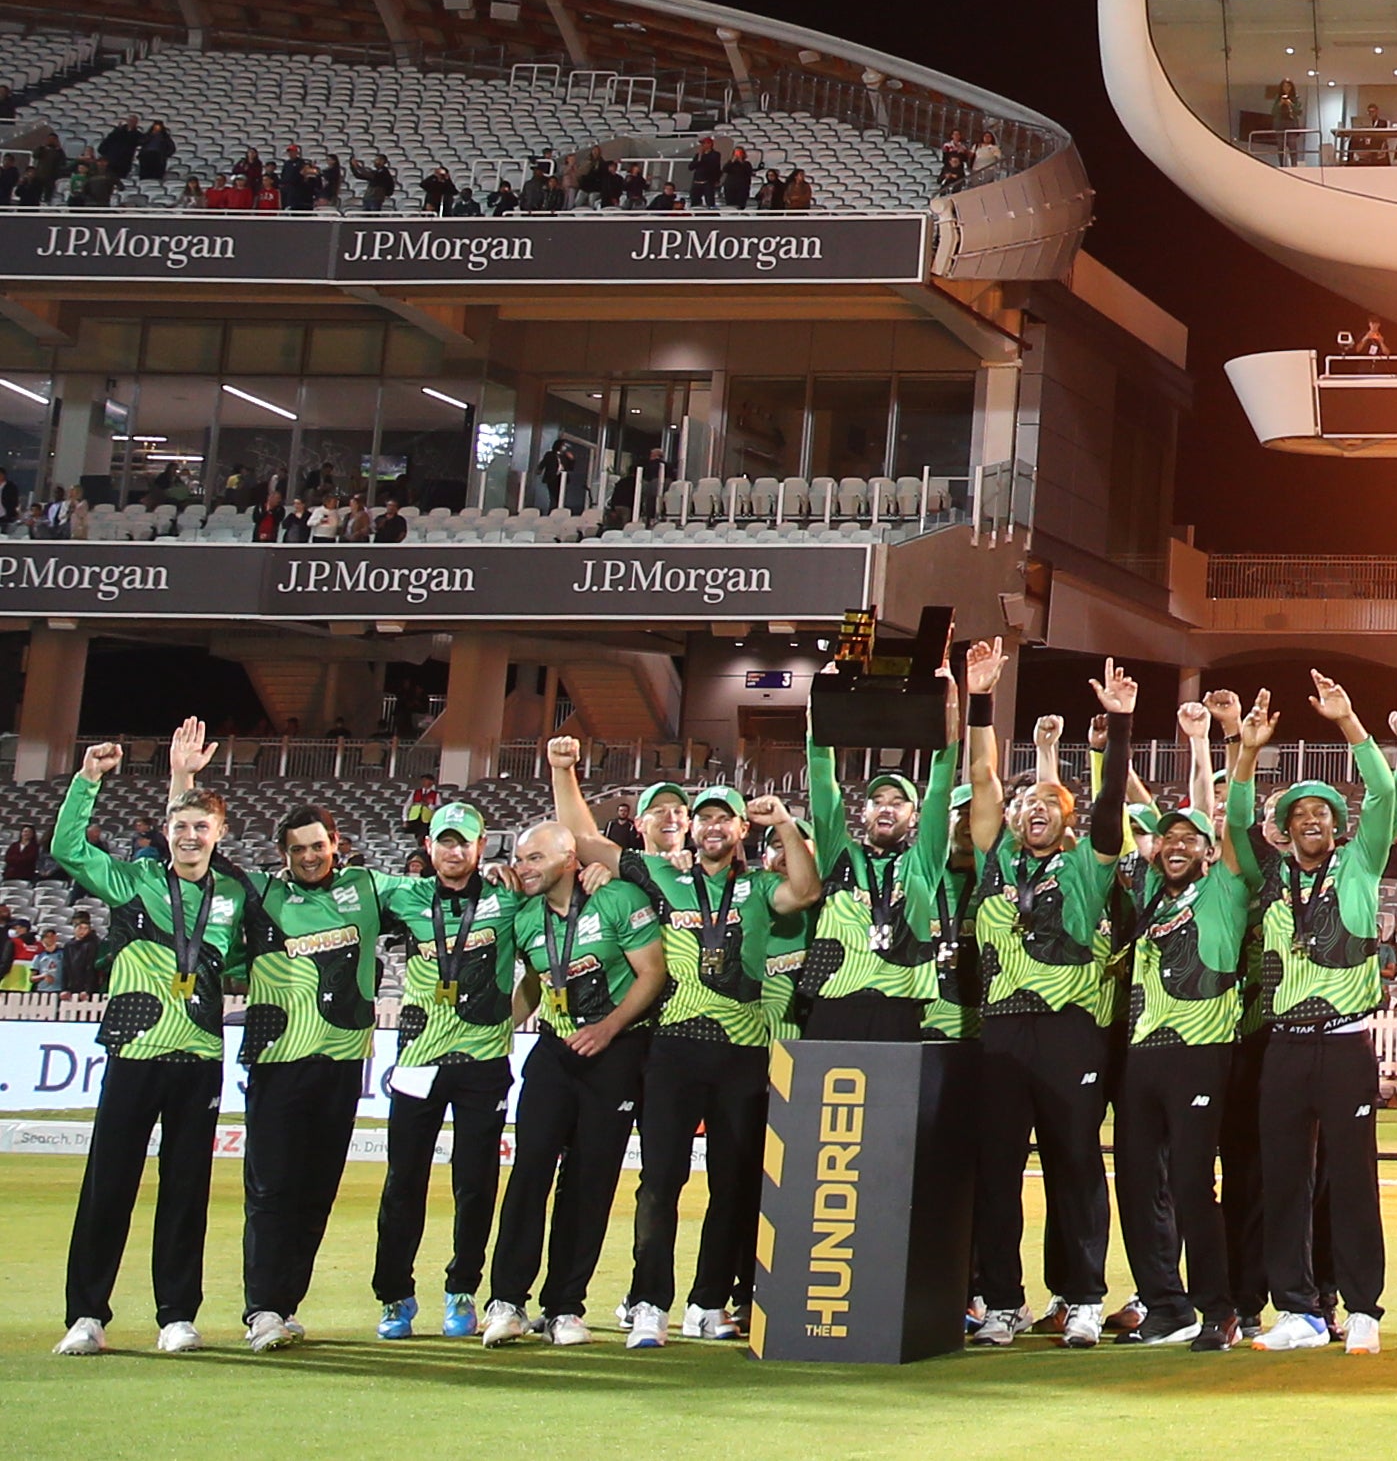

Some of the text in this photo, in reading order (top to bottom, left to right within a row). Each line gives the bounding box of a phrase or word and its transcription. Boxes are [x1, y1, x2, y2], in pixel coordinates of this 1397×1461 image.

[36, 226, 235, 269] J.P.Morgan
[344, 230, 533, 271] J.P.Morgan
[631, 229, 822, 270] J.P.Morgan
[0, 557, 169, 601] P.Morgan
[278, 560, 475, 603] J.P.Morgan
[573, 560, 772, 603] J.P.Morgan
[781, 672, 791, 687] 3
[1289, 1024, 1316, 1034] ATAK
[805, 1067, 867, 1338] THE HUNDRED
